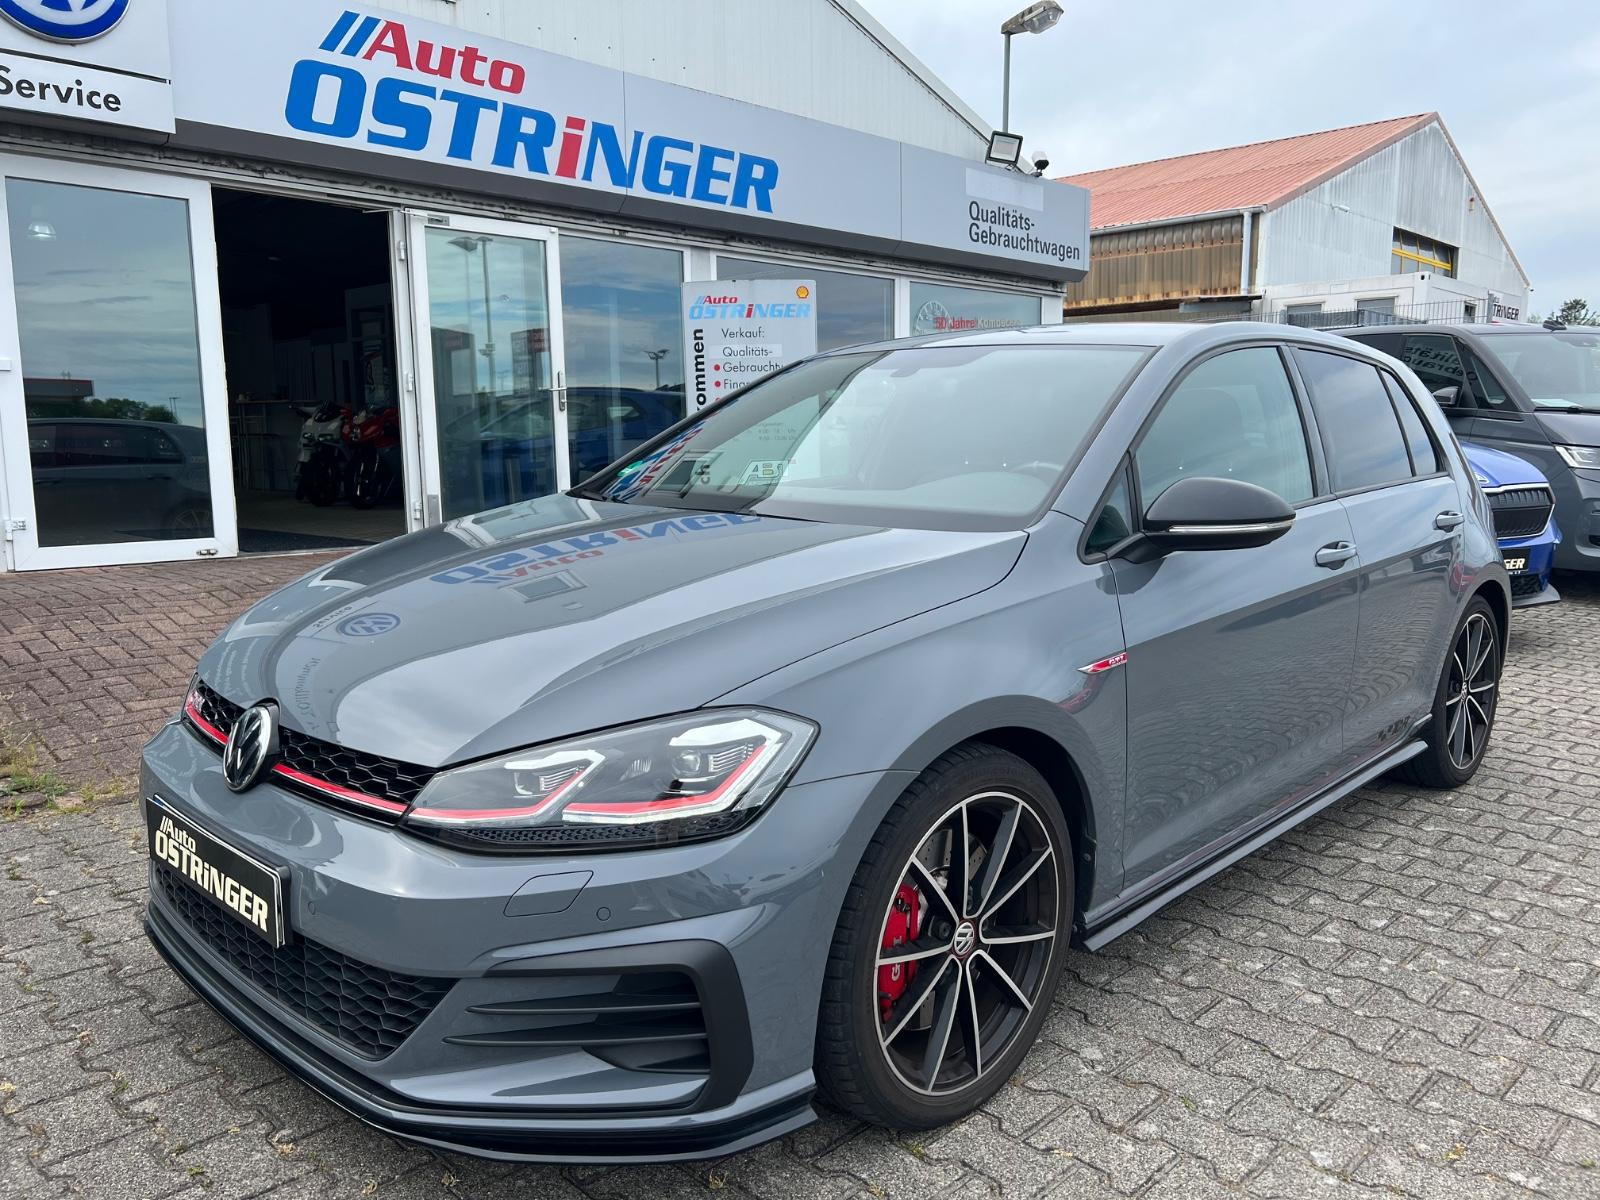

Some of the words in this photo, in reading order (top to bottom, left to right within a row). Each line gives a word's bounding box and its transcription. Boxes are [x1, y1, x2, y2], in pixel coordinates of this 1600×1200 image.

[0, 65, 122, 112] Service
[968, 200, 1035, 231] Qualitäts-
[968, 222, 1080, 262] Gebrauchtwagen
[721, 327, 765, 339] Verkauf:
[722, 346, 773, 357] Qualitäts-
[693, 328, 707, 411] ommen
